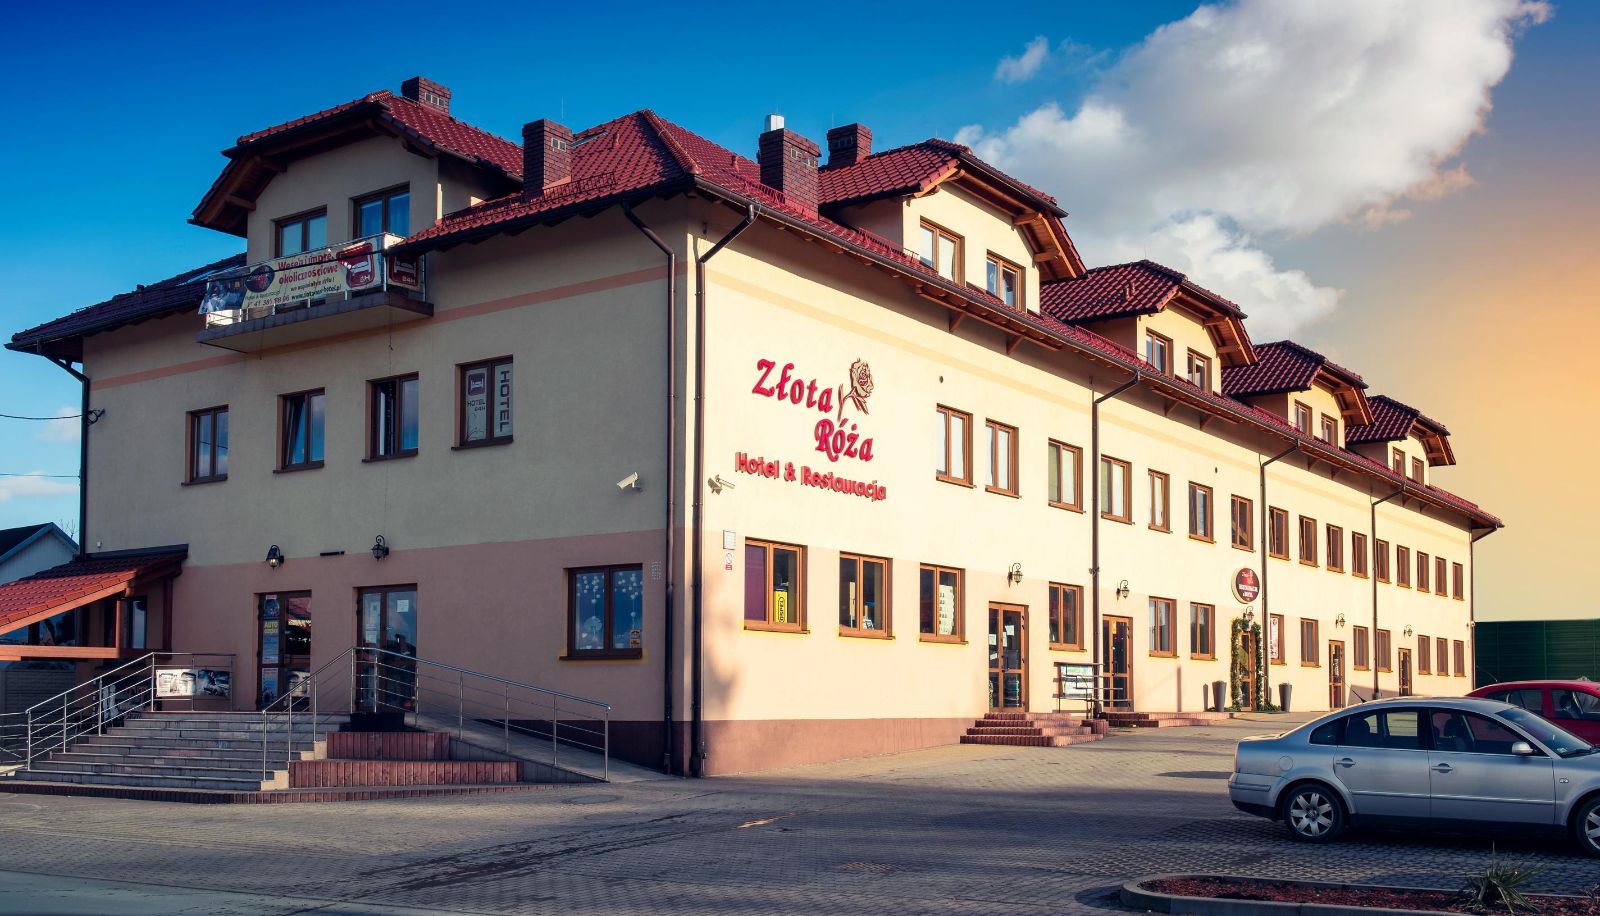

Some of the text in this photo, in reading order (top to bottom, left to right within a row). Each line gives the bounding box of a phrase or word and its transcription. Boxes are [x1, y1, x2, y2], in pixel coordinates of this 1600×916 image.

[278, 264, 338, 284] okolicznościowe
[402, 275, 415, 285] 24H
[467, 399, 485, 408] HOTEL
[500, 371, 510, 432] HOTEL
[752, 358, 833, 413] Złota
[814, 417, 874, 462] Róża
[734, 451, 887, 502] Hotel & Restauracja
